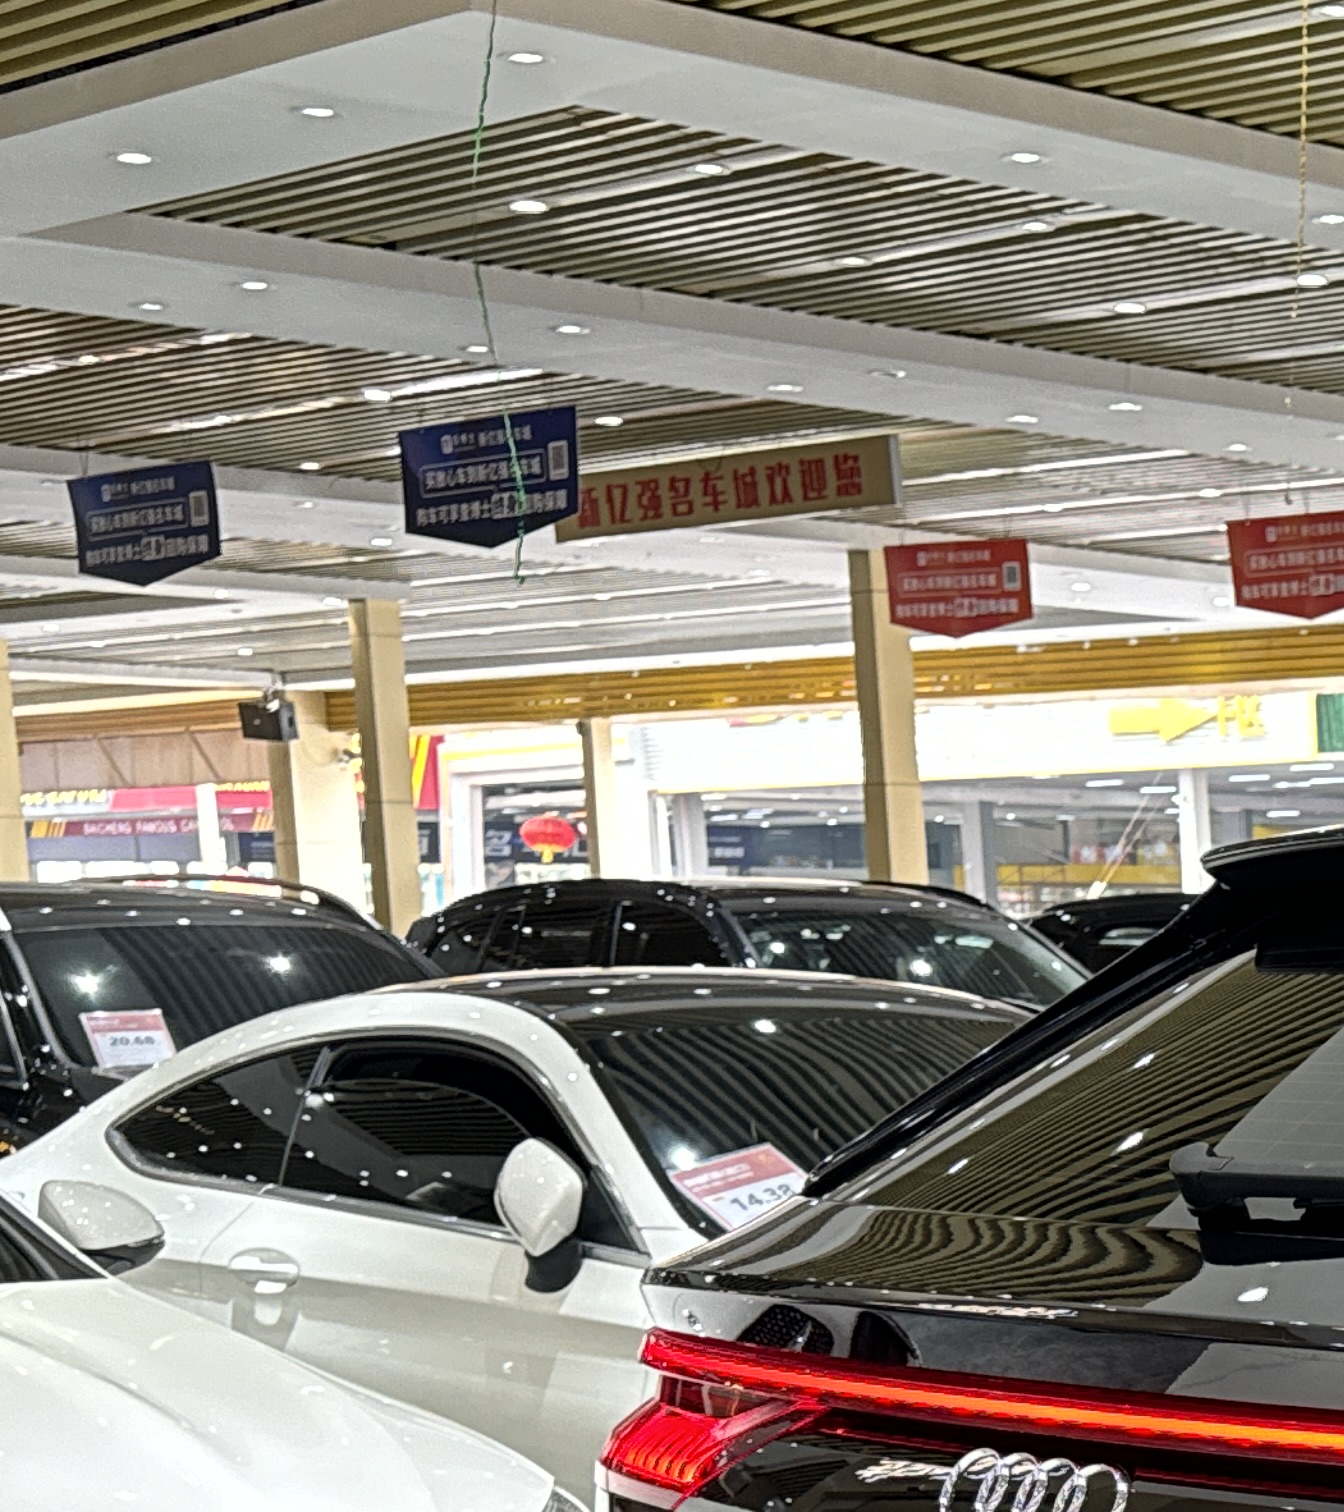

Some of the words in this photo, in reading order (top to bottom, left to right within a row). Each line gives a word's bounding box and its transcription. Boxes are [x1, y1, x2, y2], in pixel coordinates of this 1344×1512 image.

[578, 453, 862, 528] 新亿强名车城欢迎您
